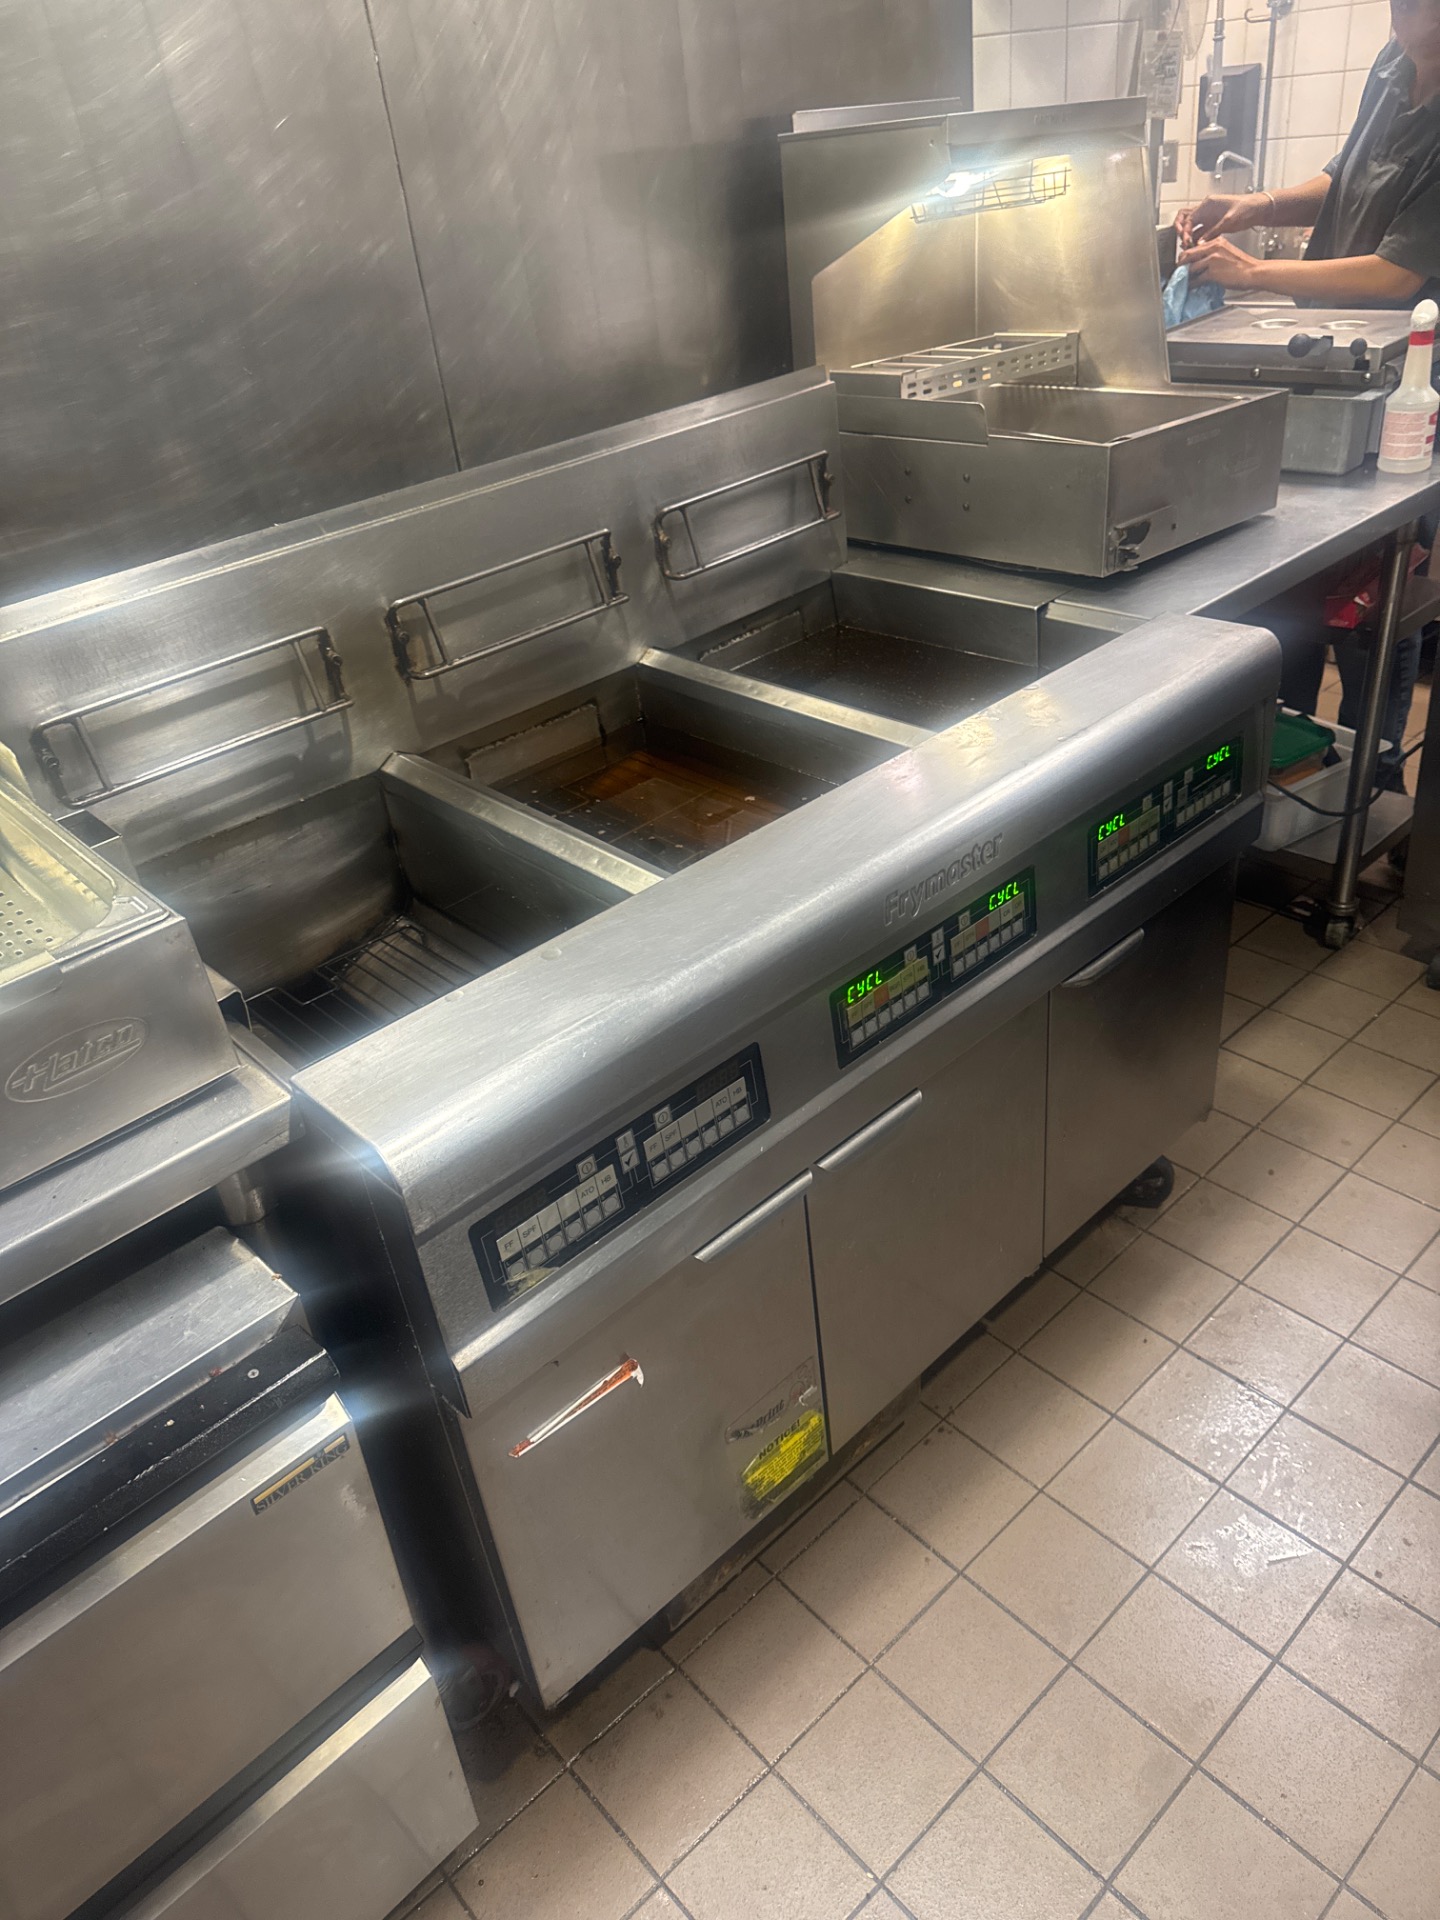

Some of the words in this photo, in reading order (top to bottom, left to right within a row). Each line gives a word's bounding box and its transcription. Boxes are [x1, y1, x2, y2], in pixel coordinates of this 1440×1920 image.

[884, 832, 1004, 927] Frymaster
[12, 1023, 142, 1094] Hatco
[715, 1096, 728, 1108] ATO
[600, 1174, 612, 1186] HB
[580, 1186, 595, 1200] ATO
[521, 1224, 536, 1239] SPF
[504, 1239, 514, 1251] FF
[758, 1418, 801, 1460] NOTICE!
[256, 1472, 307, 1514] SILVER
[309, 1444, 350, 1476] KING
